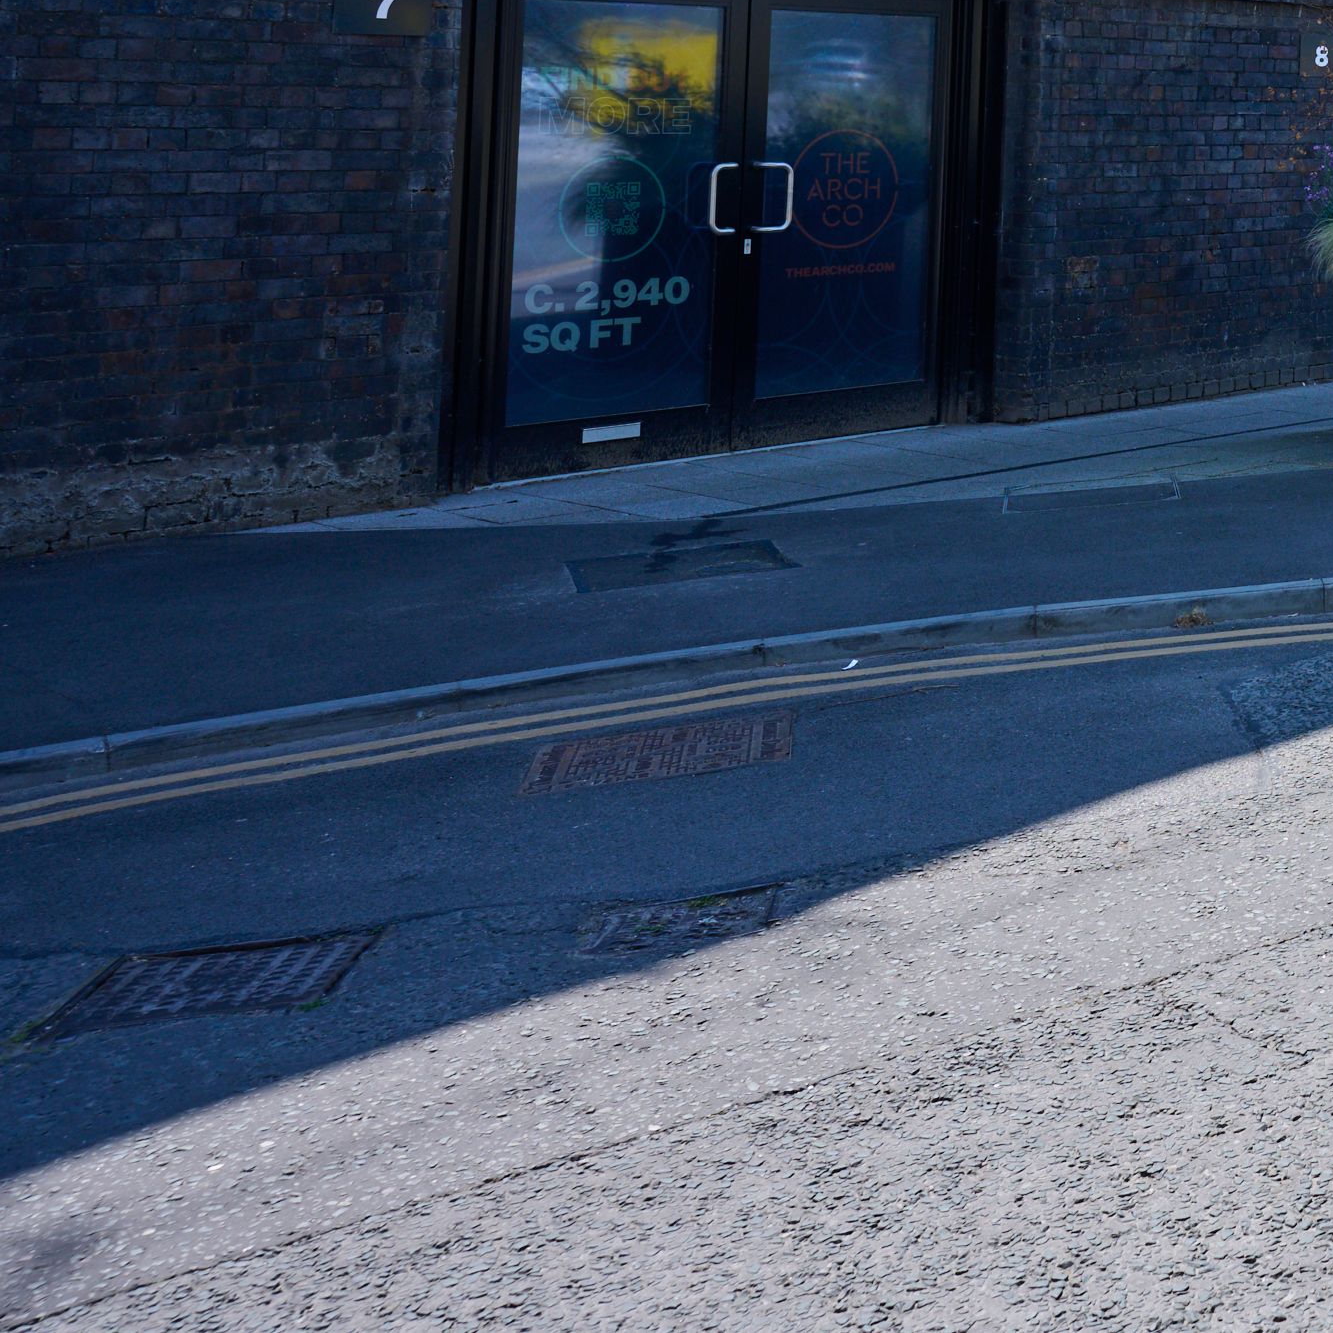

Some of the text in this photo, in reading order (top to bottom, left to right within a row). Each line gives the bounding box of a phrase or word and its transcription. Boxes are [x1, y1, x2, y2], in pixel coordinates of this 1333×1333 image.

[1314, 45, 1329, 67] 8
[540, 67, 615, 92] FIND
[538, 96, 693, 135] MORE
[820, 152, 870, 175] THE
[807, 178, 881, 201] ARCH
[822, 204, 863, 227] CO
[785, 263, 896, 278] THEARCHCO.COM
[524, 276, 690, 316] C. 2,940
[522, 317, 641, 354] SQ FT
